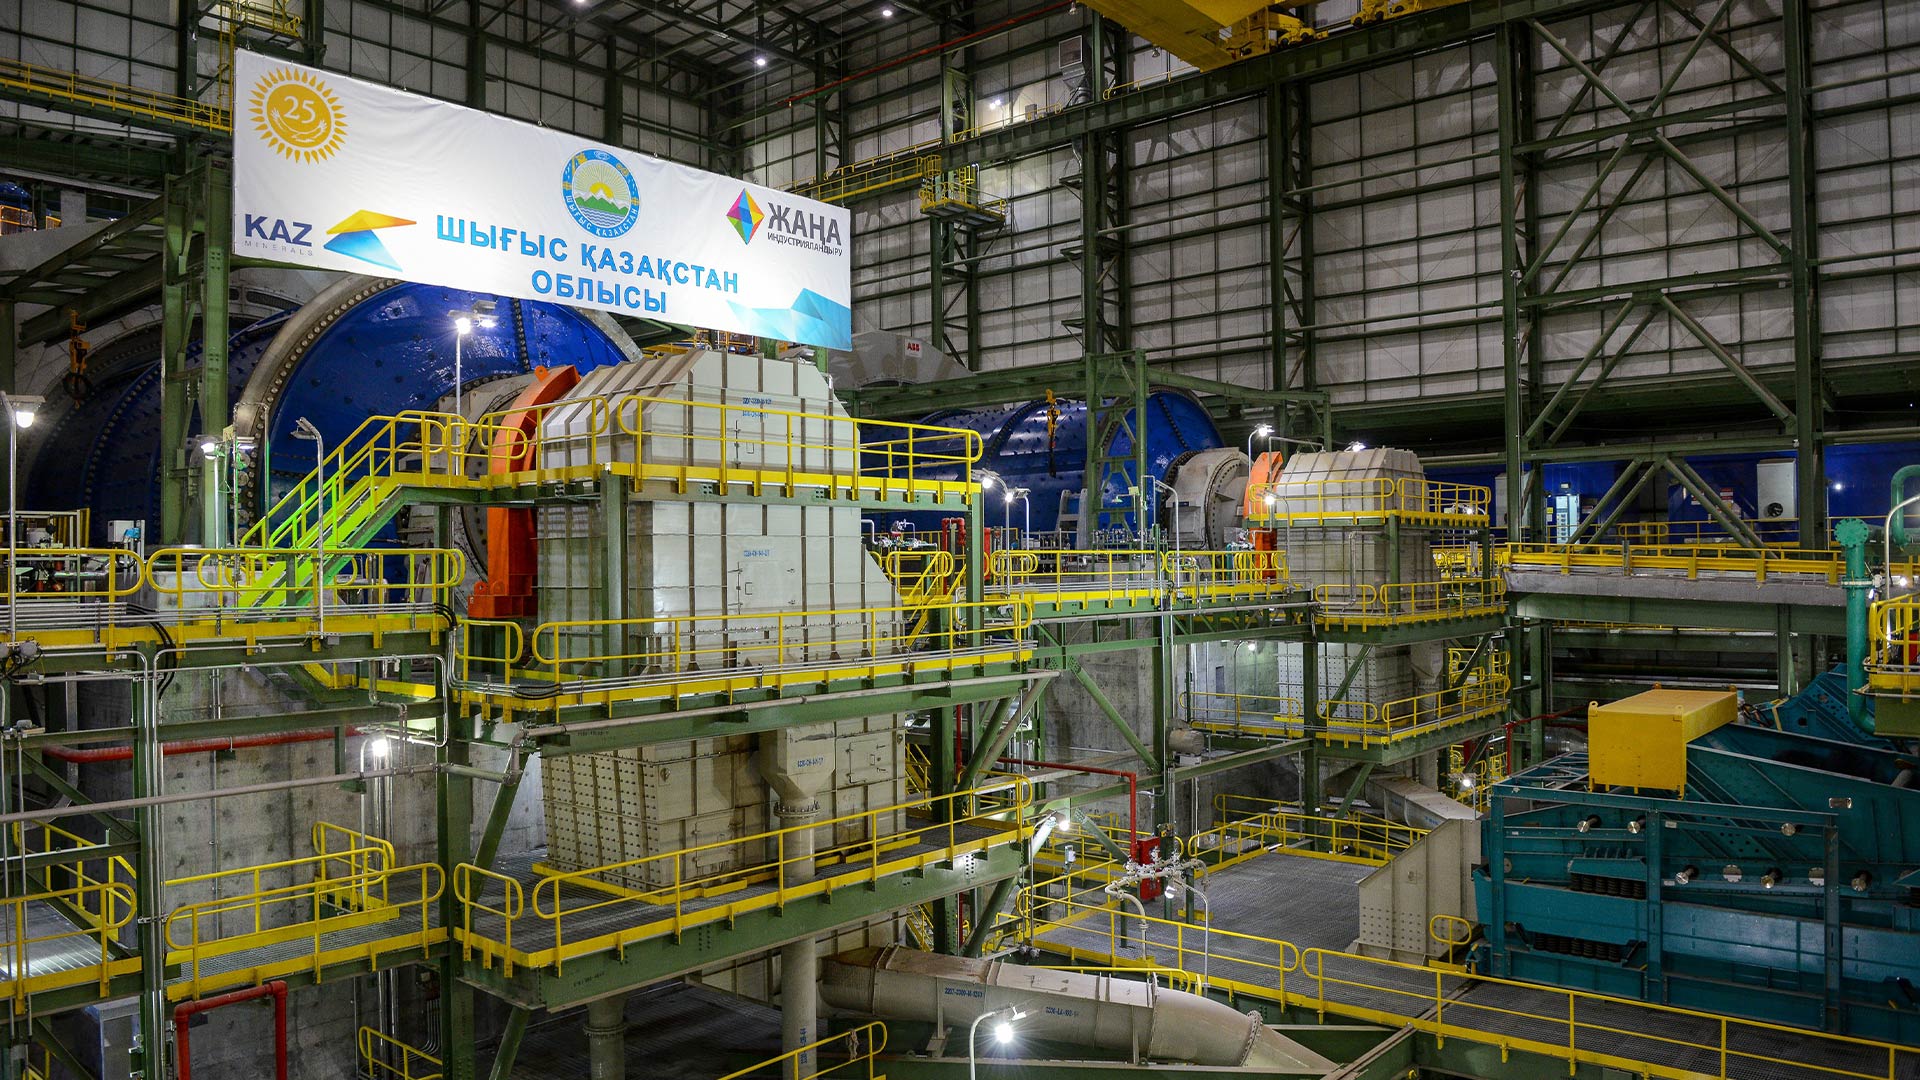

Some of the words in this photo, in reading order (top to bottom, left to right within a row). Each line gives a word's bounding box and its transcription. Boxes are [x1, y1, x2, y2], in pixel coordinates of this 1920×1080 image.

[284, 95, 316, 124] 25
[245, 213, 313, 247] KAZ
[767, 202, 842, 246] ЖАҢА
[244, 240, 313, 256] MINERALS
[437, 214, 568, 262] ШЫҒЫС
[580, 243, 739, 294] ҚАЗАҚСТАН
[767, 231, 843, 257] ИНДУСТРИЯЛАНДЫРУ
[531, 269, 667, 314] ОБЛЫСЫ
